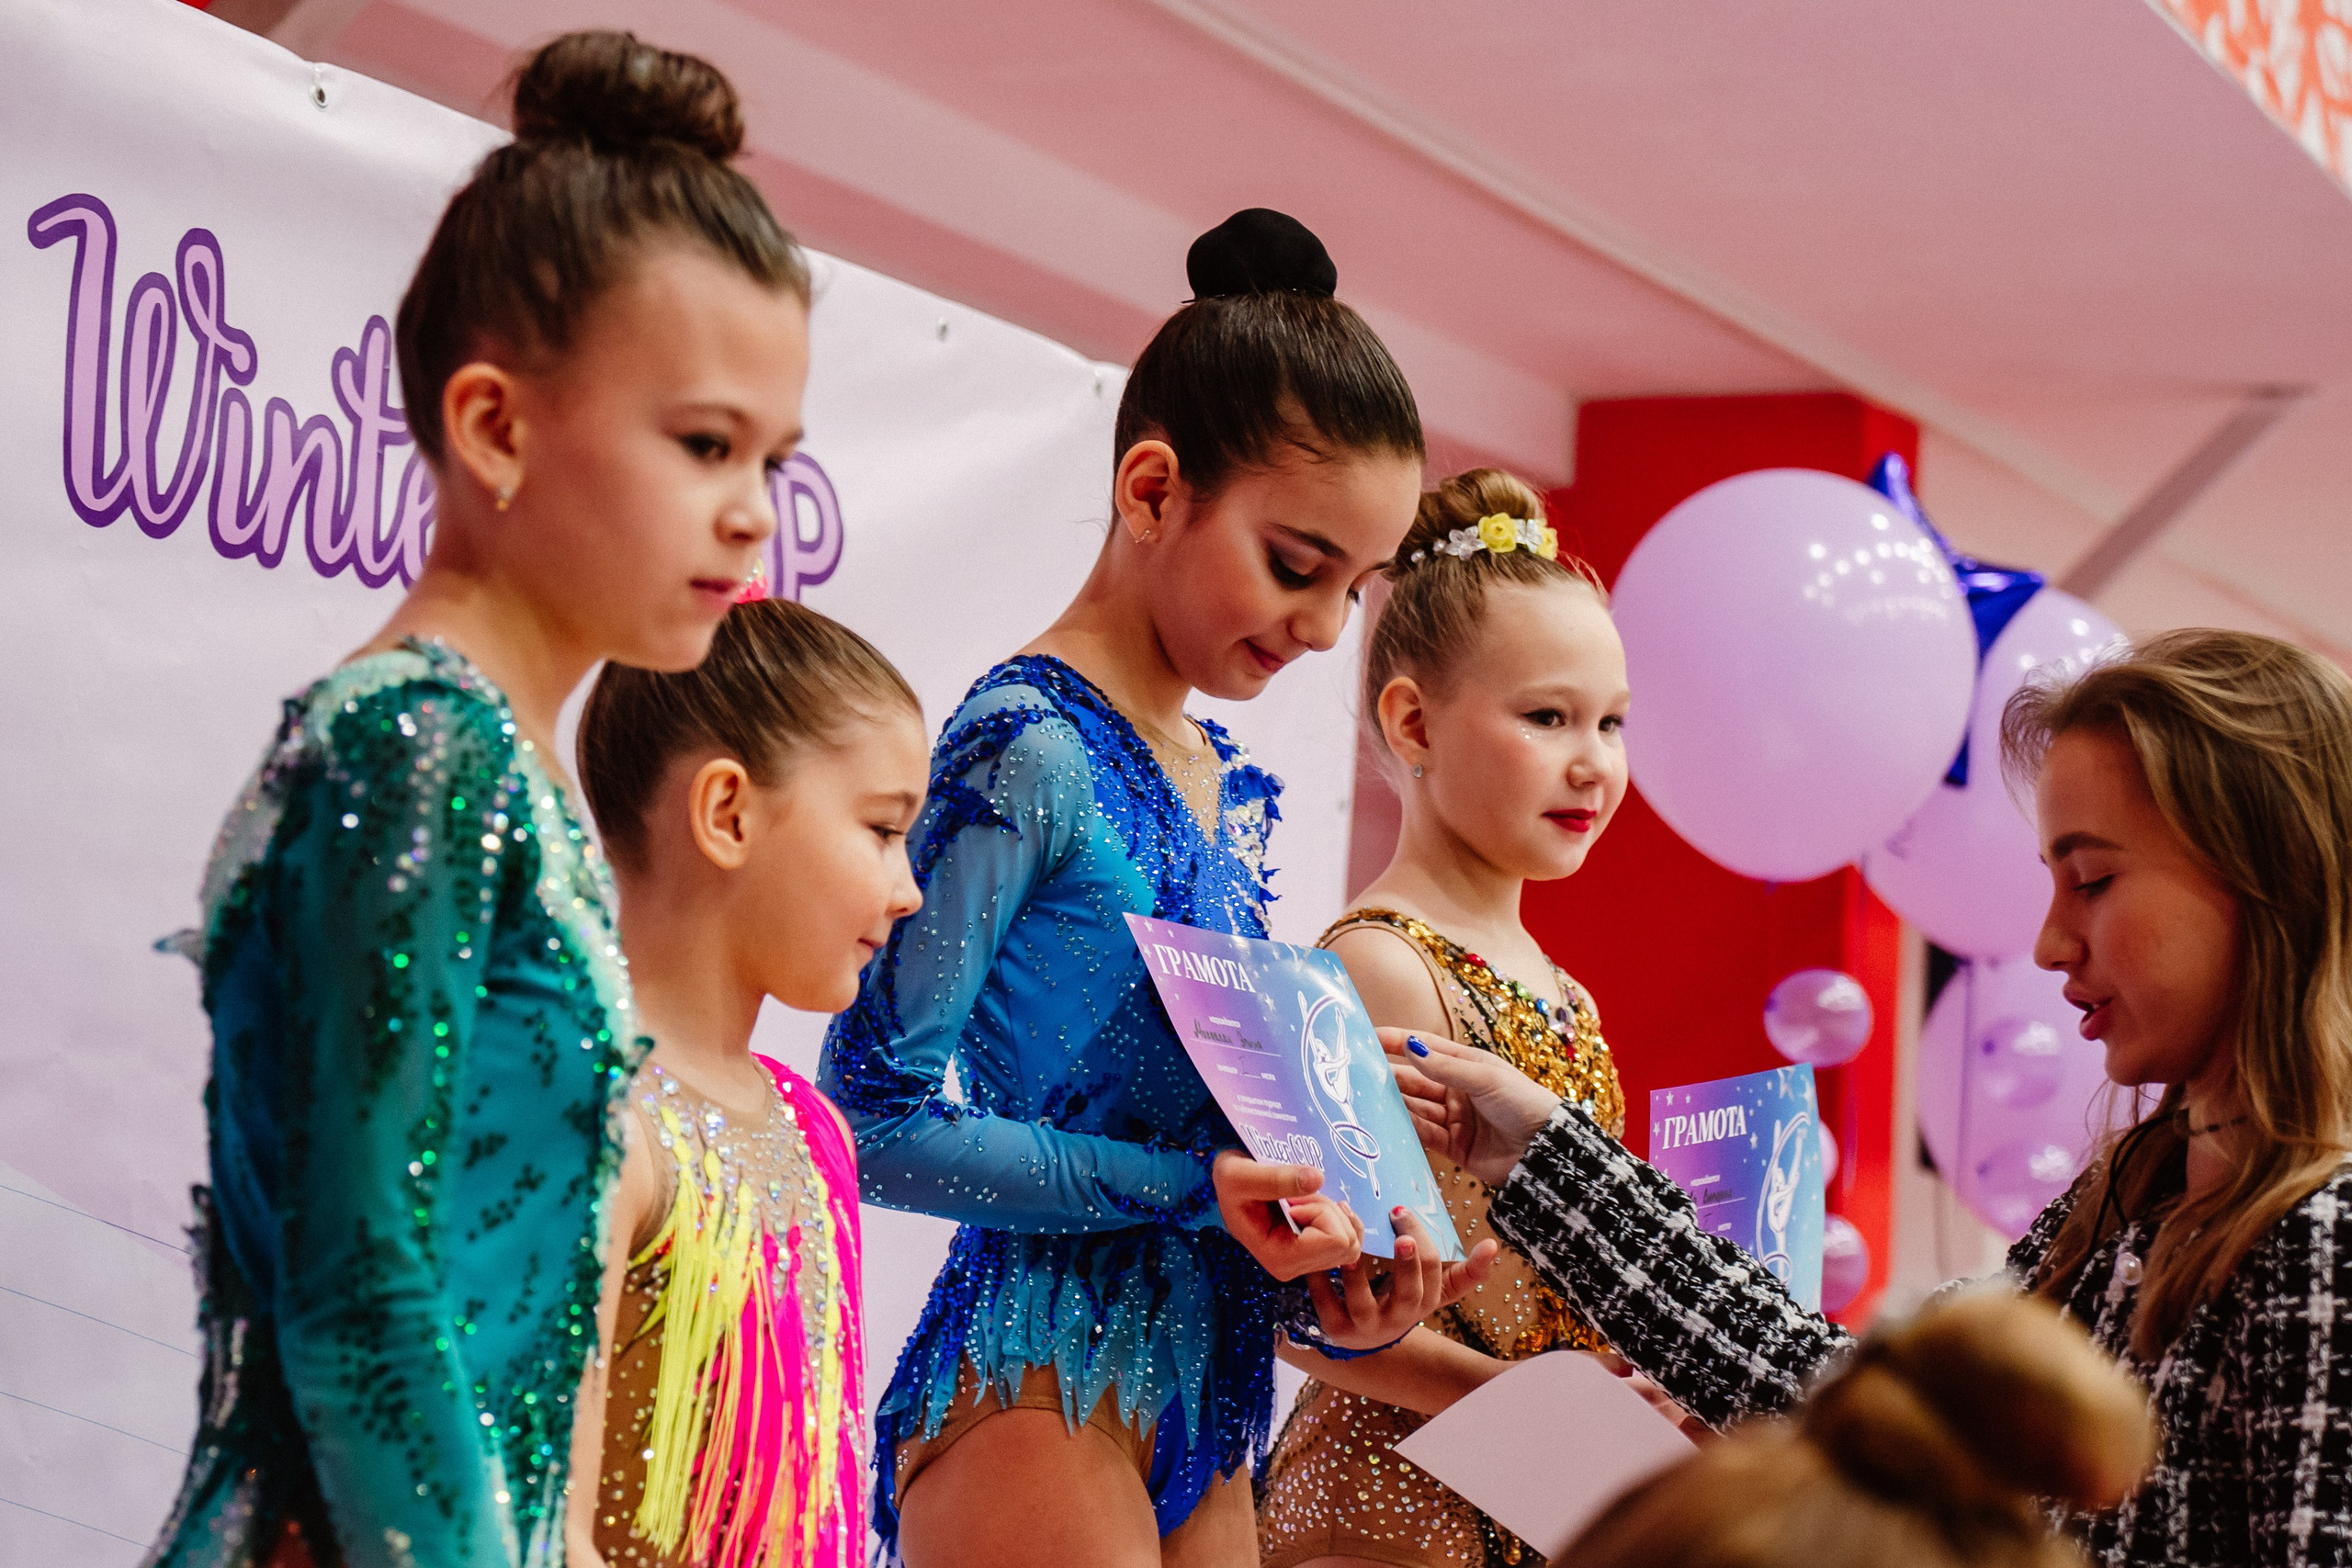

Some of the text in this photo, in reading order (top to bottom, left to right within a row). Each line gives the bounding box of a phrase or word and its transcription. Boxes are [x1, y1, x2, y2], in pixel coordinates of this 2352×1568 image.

[28, 193, 437, 590] Winte
[1152, 943, 1257, 994] ГРАМОТА
[1662, 1105, 1747, 1150] ГРАМОТА
